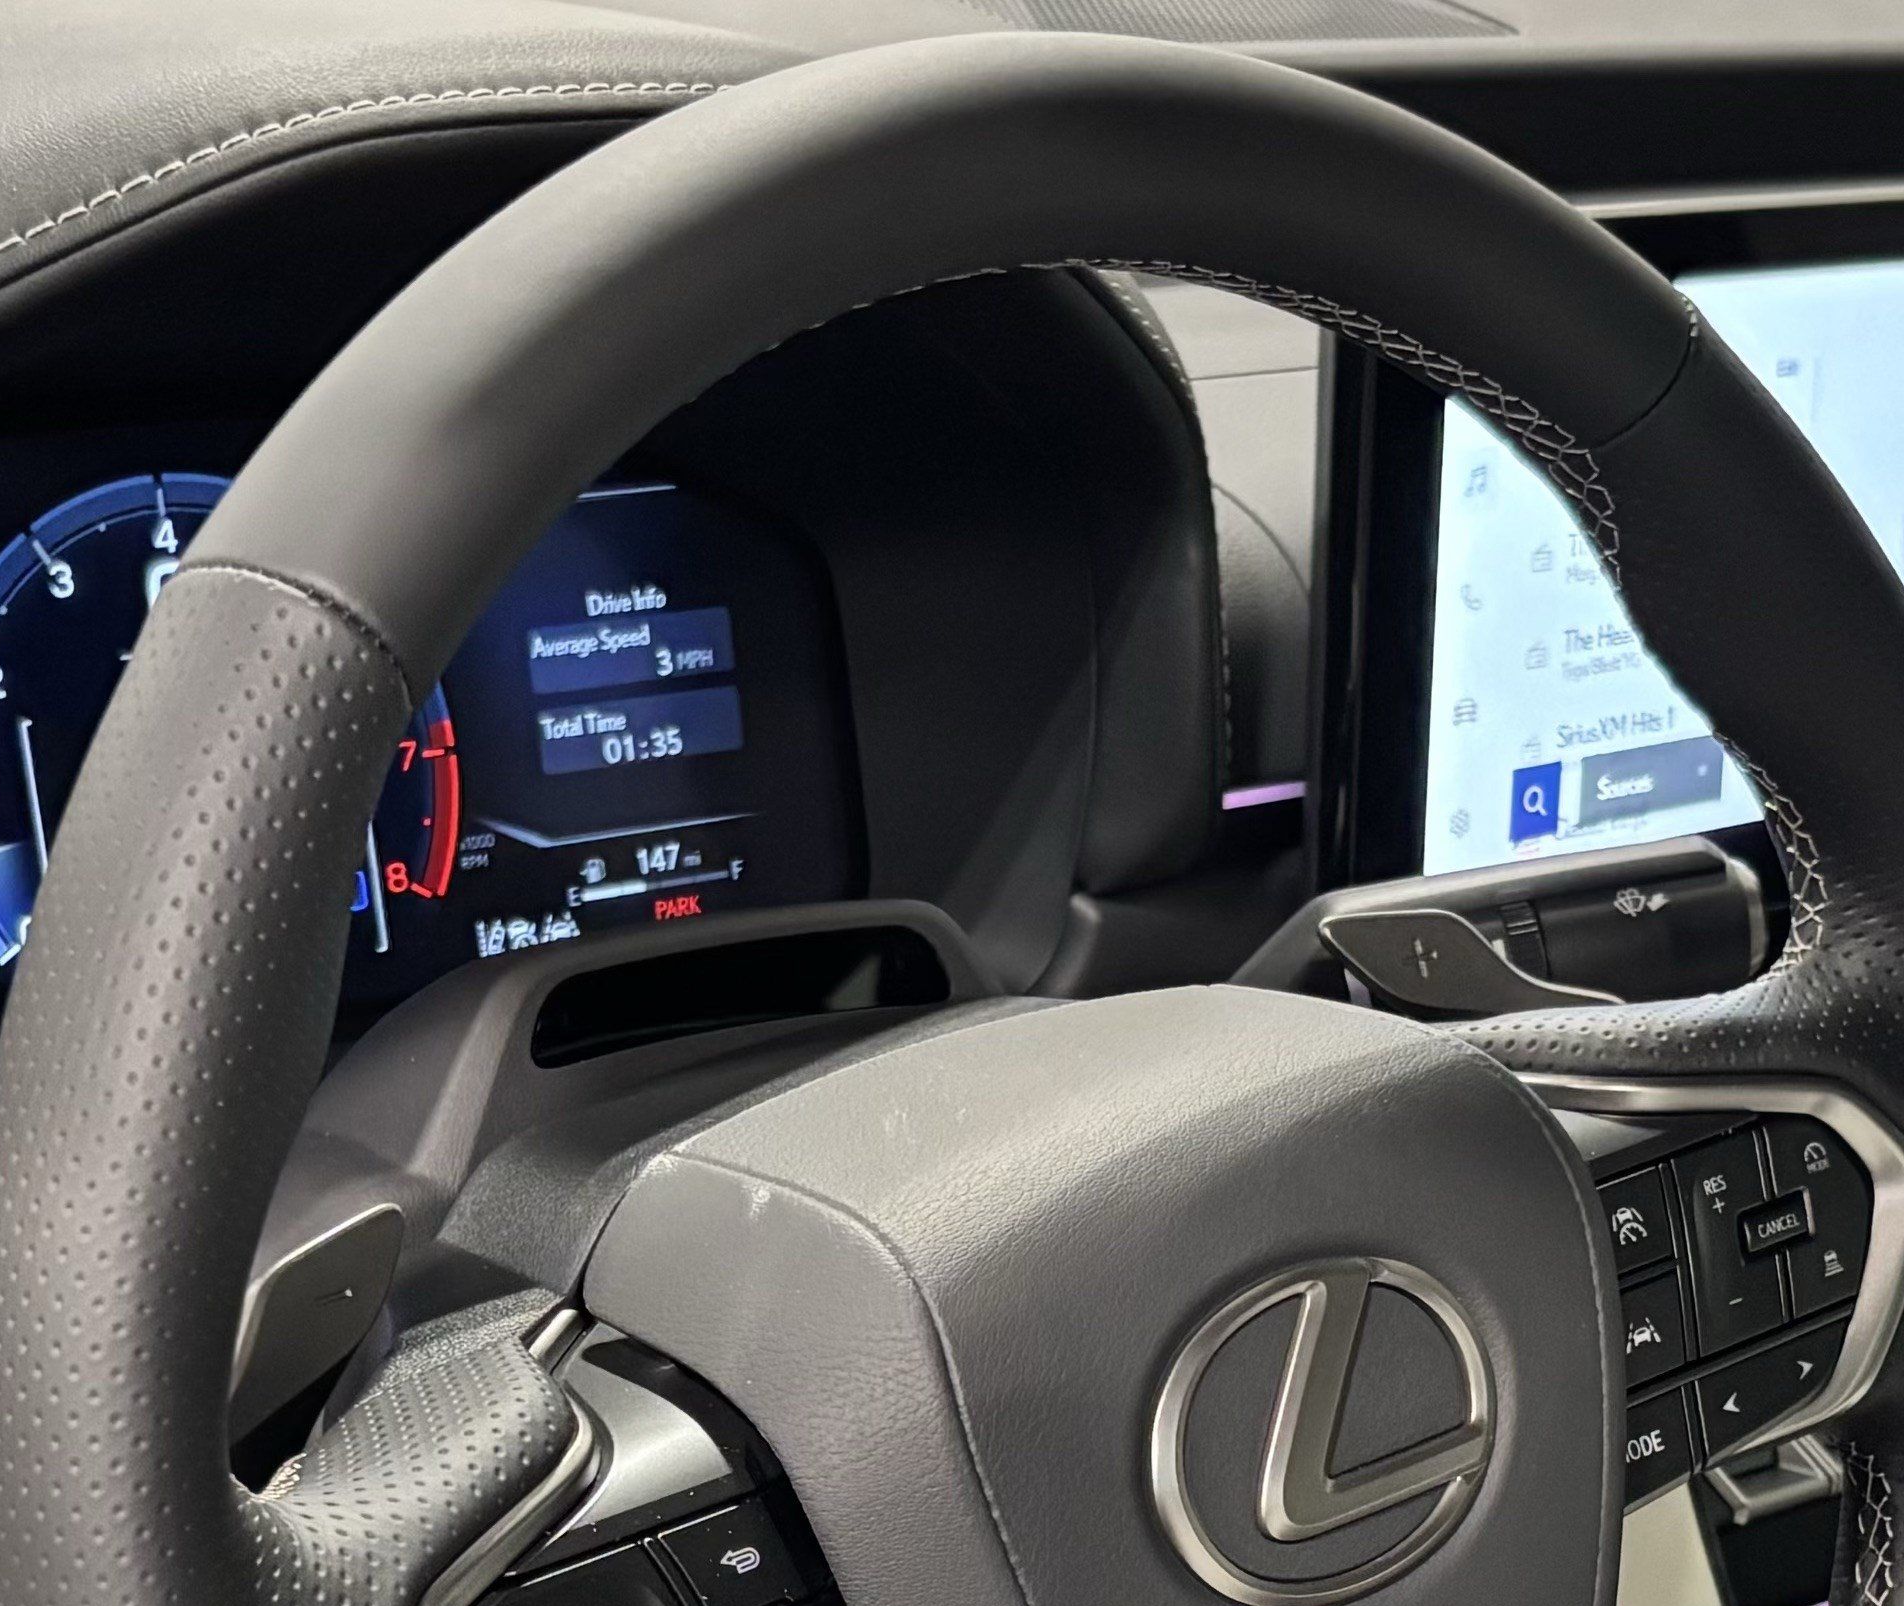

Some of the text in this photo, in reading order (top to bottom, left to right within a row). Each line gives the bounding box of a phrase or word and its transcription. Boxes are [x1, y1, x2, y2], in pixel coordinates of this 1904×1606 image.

[155, 520, 178, 553] 4
[49, 564, 75, 598] 3
[585, 586, 667, 618] Drive Info
[530, 624, 651, 661] Average Speed
[655, 646, 714, 677] 3 MPH
[540, 712, 627, 740] Total Time
[398, 741, 416, 771] 7
[602, 728, 683, 765] 01:35
[636, 843, 680, 875] 147
[384, 862, 409, 892] 8
[654, 896, 702, 920] PARK
[1703, 1175, 1727, 1195] RES
[1757, 1212, 1800, 1239] CANCEL
[1626, 1429, 1665, 1464] ODE
